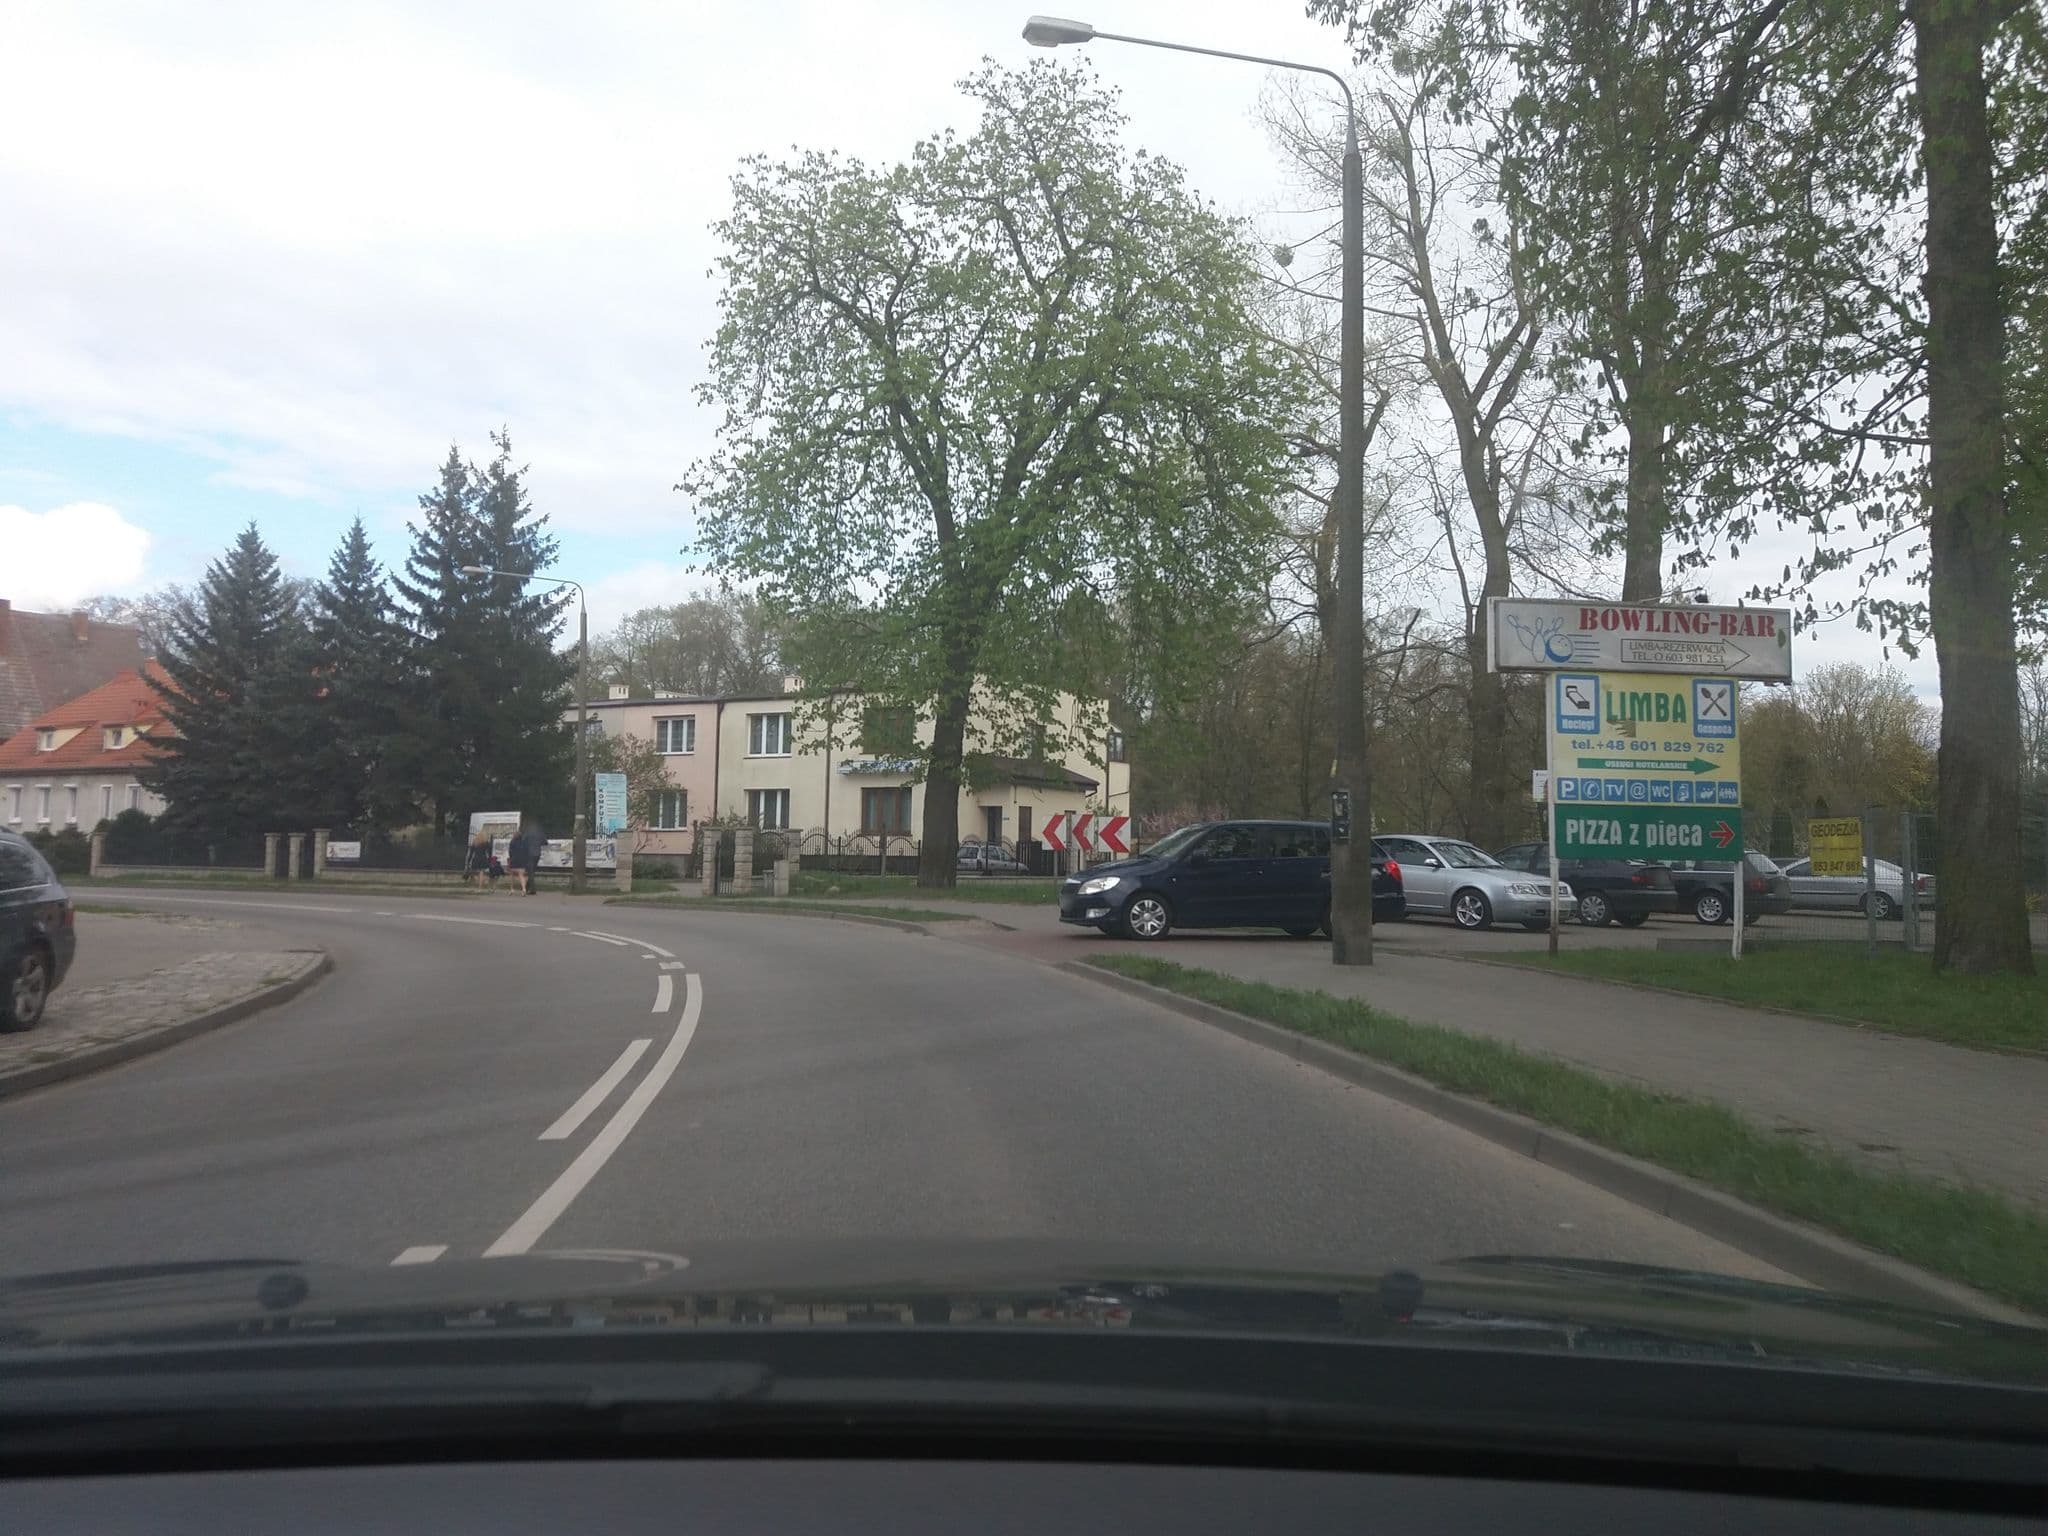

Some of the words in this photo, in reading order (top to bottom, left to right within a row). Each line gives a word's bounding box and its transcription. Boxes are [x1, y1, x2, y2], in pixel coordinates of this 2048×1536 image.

[1579, 607, 1777, 638] BOWLING-BAR
[1629, 641, 1727, 655] LIMBA-REZERWACJA
[1686, 653, 1703, 663] 981
[1706, 654, 1724, 664] 253
[1606, 691, 1687, 723] LIMBA
[1630, 742, 1657, 751] 601
[1664, 742, 1692, 752] 829
[1698, 742, 1725, 753] 762
[1561, 780, 1575, 797] P
[1606, 784, 1624, 796] TV
[1651, 785, 1670, 798] WC
[1566, 818, 1622, 845] PIZZA
[1629, 823, 1640, 845] z
[1646, 820, 1702, 848] pieca
